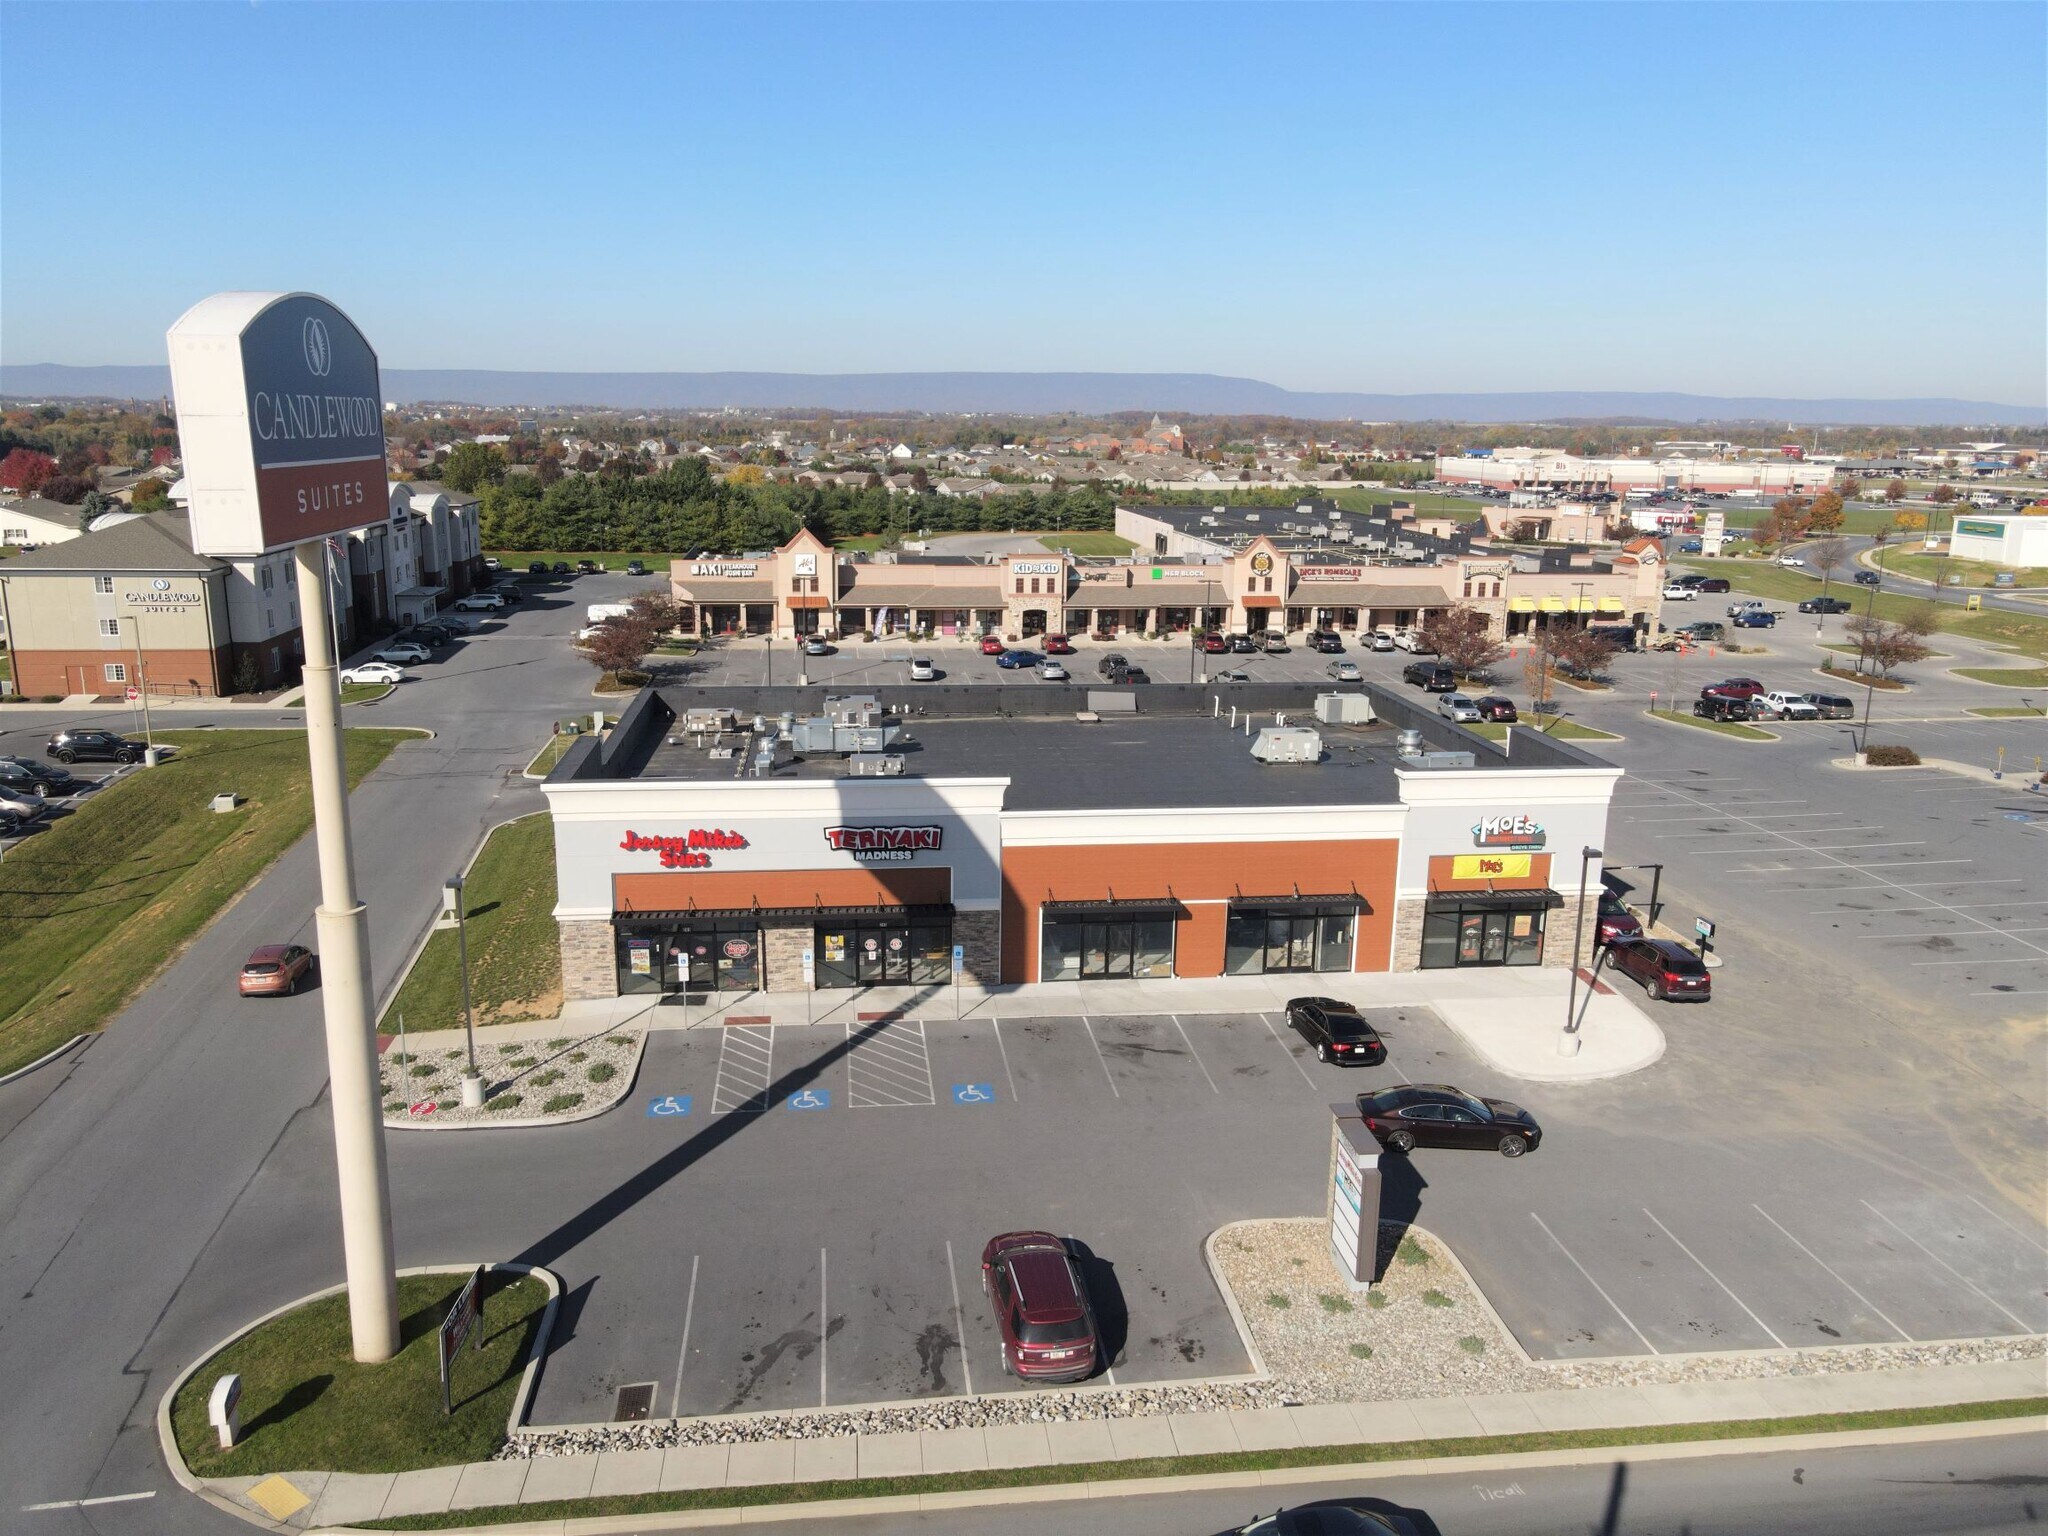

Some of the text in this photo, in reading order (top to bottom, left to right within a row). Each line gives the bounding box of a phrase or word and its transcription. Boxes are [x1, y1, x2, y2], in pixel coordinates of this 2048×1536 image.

[254, 391, 379, 441] CANDLEWOOD
[297, 481, 363, 513] SUITES
[700, 563, 722, 576] AKI
[620, 829, 745, 852] Jersey Mike's
[827, 828, 940, 849] TERIYAKI
[855, 851, 912, 860] MADNESS
